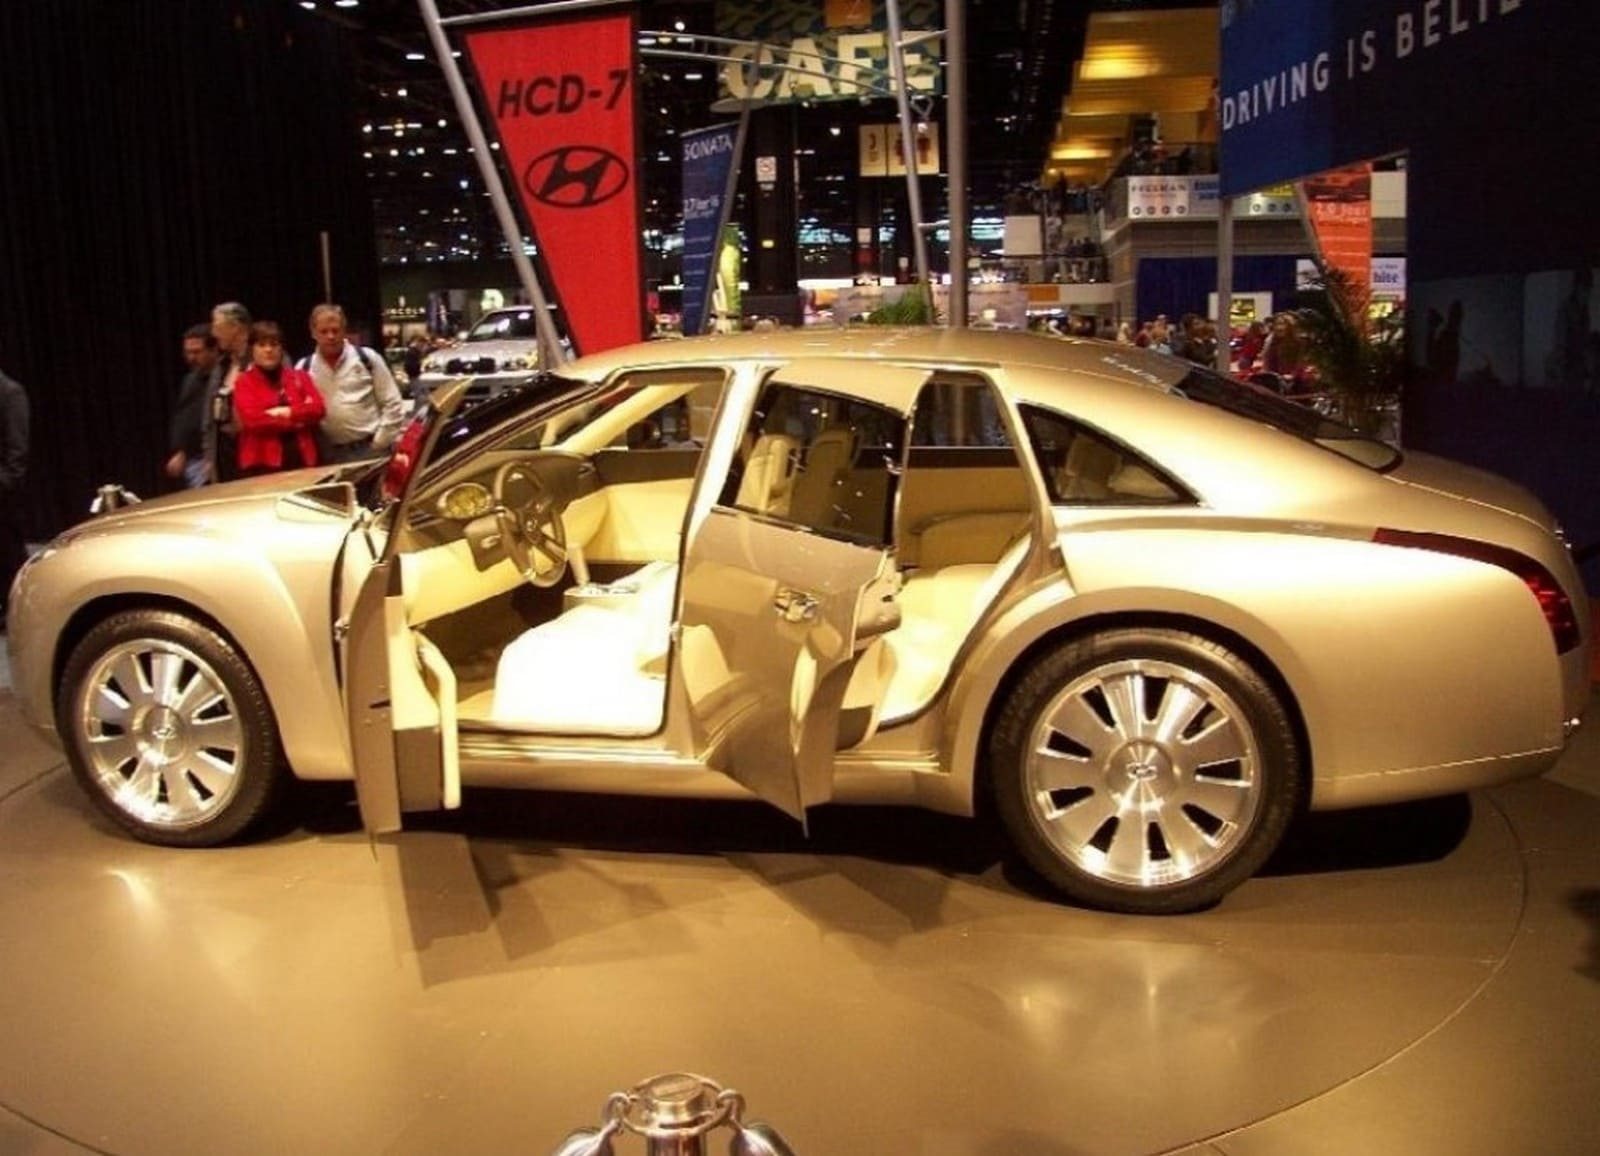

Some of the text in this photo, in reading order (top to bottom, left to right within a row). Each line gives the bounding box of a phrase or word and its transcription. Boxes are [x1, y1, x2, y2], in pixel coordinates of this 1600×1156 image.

[498, 69, 628, 119] HCD-7
[722, 31, 941, 100] CAFE
[1223, 52, 1329, 130] DRIVING
[1347, 30, 1376, 80] IS
[684, 133, 733, 162] SONATA
